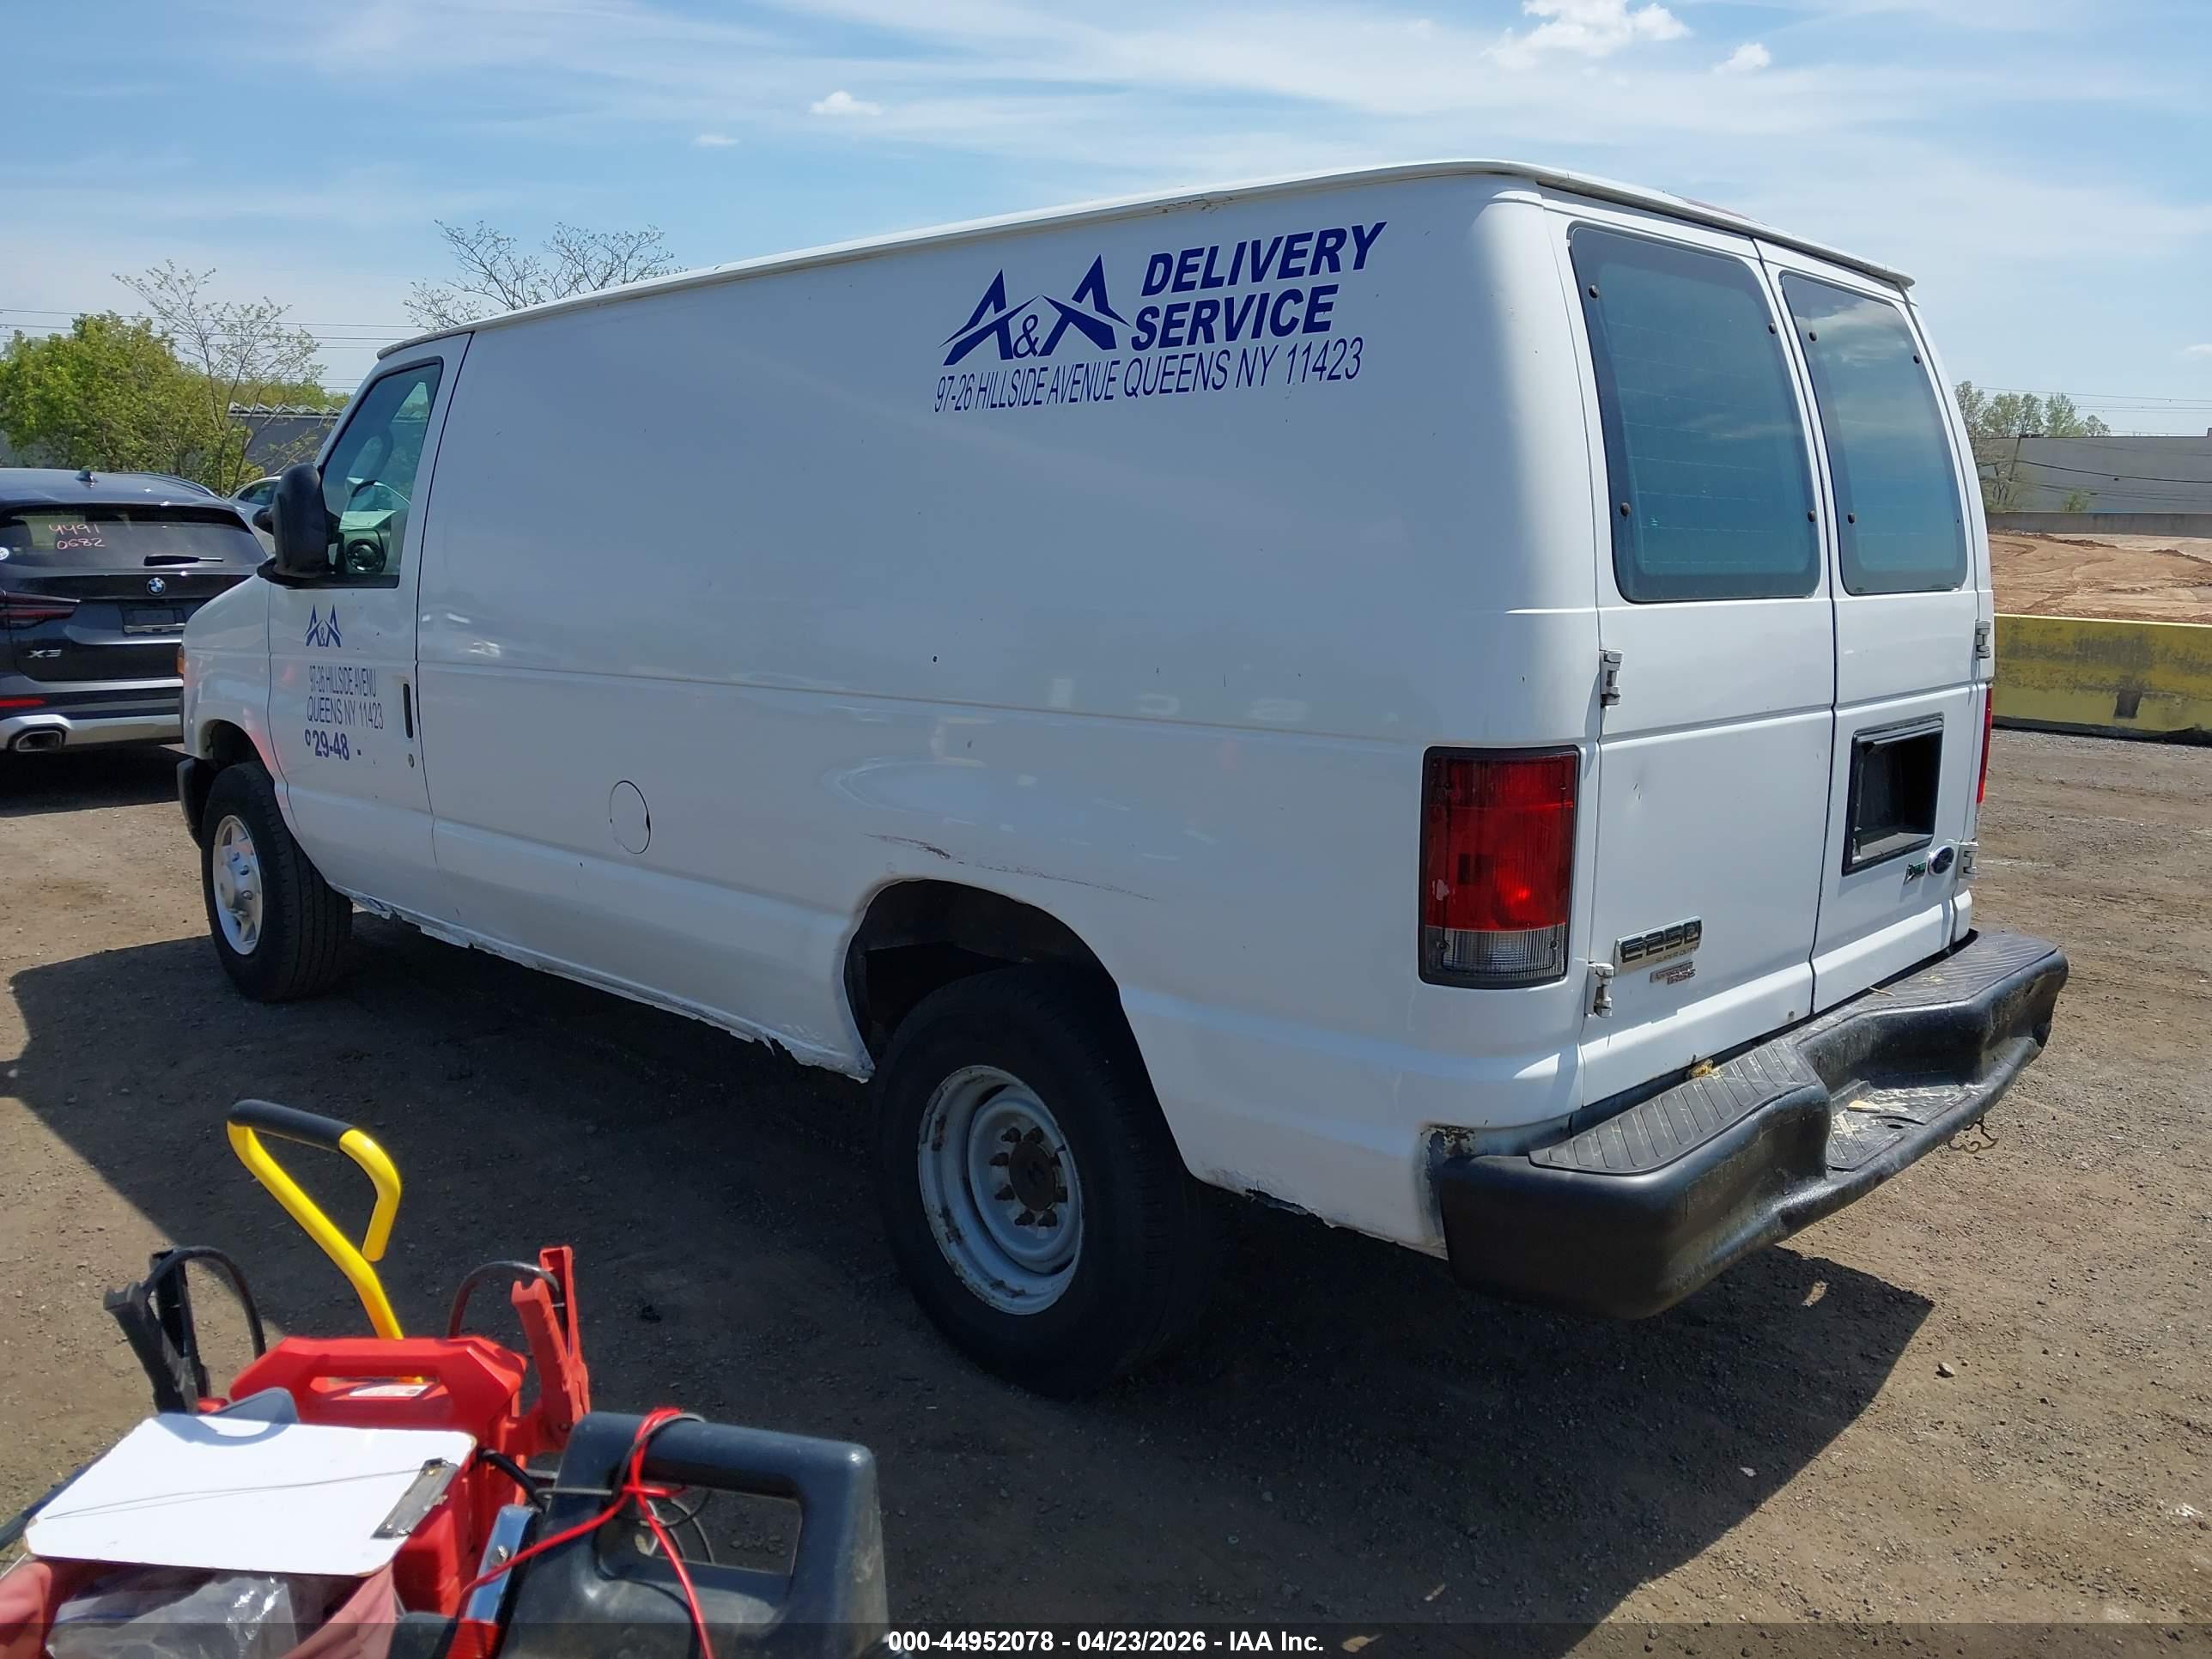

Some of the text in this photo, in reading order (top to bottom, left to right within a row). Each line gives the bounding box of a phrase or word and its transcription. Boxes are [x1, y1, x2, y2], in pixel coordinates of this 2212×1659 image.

[1140, 222, 1388, 297] DELIVERY
[1131, 283, 1340, 352] SERVICE
[934, 336, 1364, 413] 97-26 HILLSIDE AVENUE QUEENS NY 11423
[48, 523, 100, 535] 4491
[27, 649, 62, 659] X3
[325, 666, 353, 696] HILLSIDE
[307, 696, 384, 730] QUEENS NY 11423
